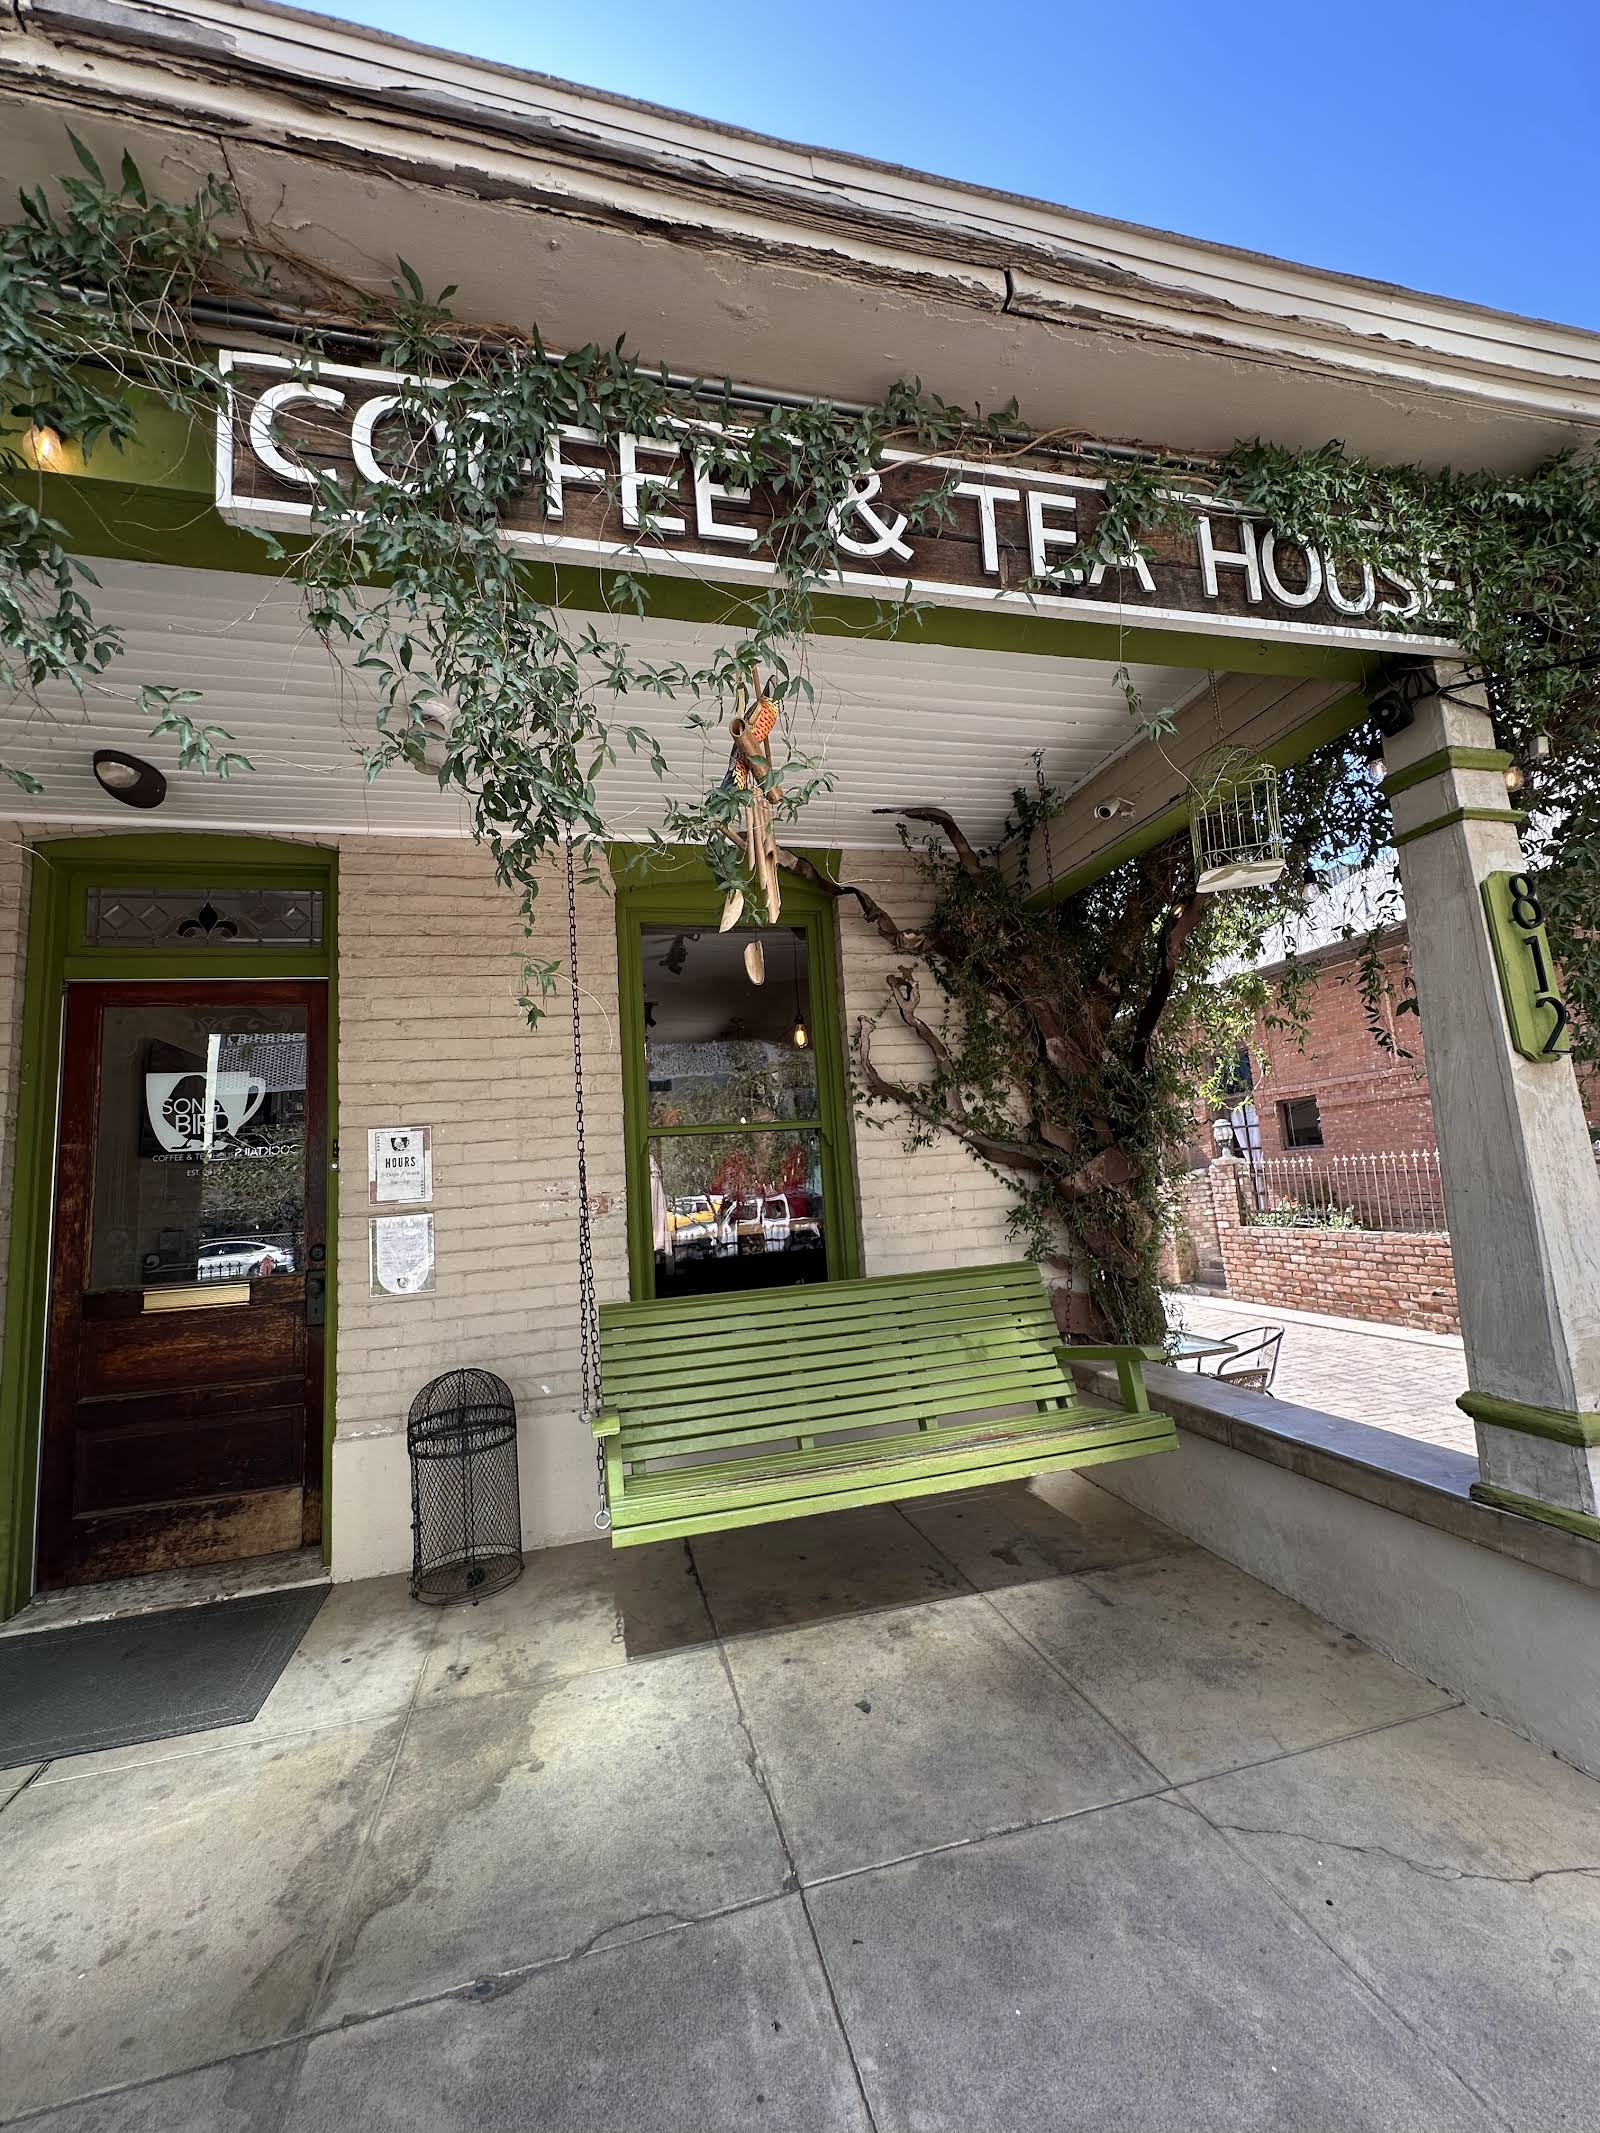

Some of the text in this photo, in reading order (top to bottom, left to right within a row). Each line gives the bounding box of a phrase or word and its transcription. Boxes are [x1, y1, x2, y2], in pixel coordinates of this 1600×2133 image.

[827, 466, 915, 563] &
[1509, 873, 1573, 1053] 812
[152, 1153, 185, 1163] COFFEE
[385, 1156, 416, 1168] HOURS
